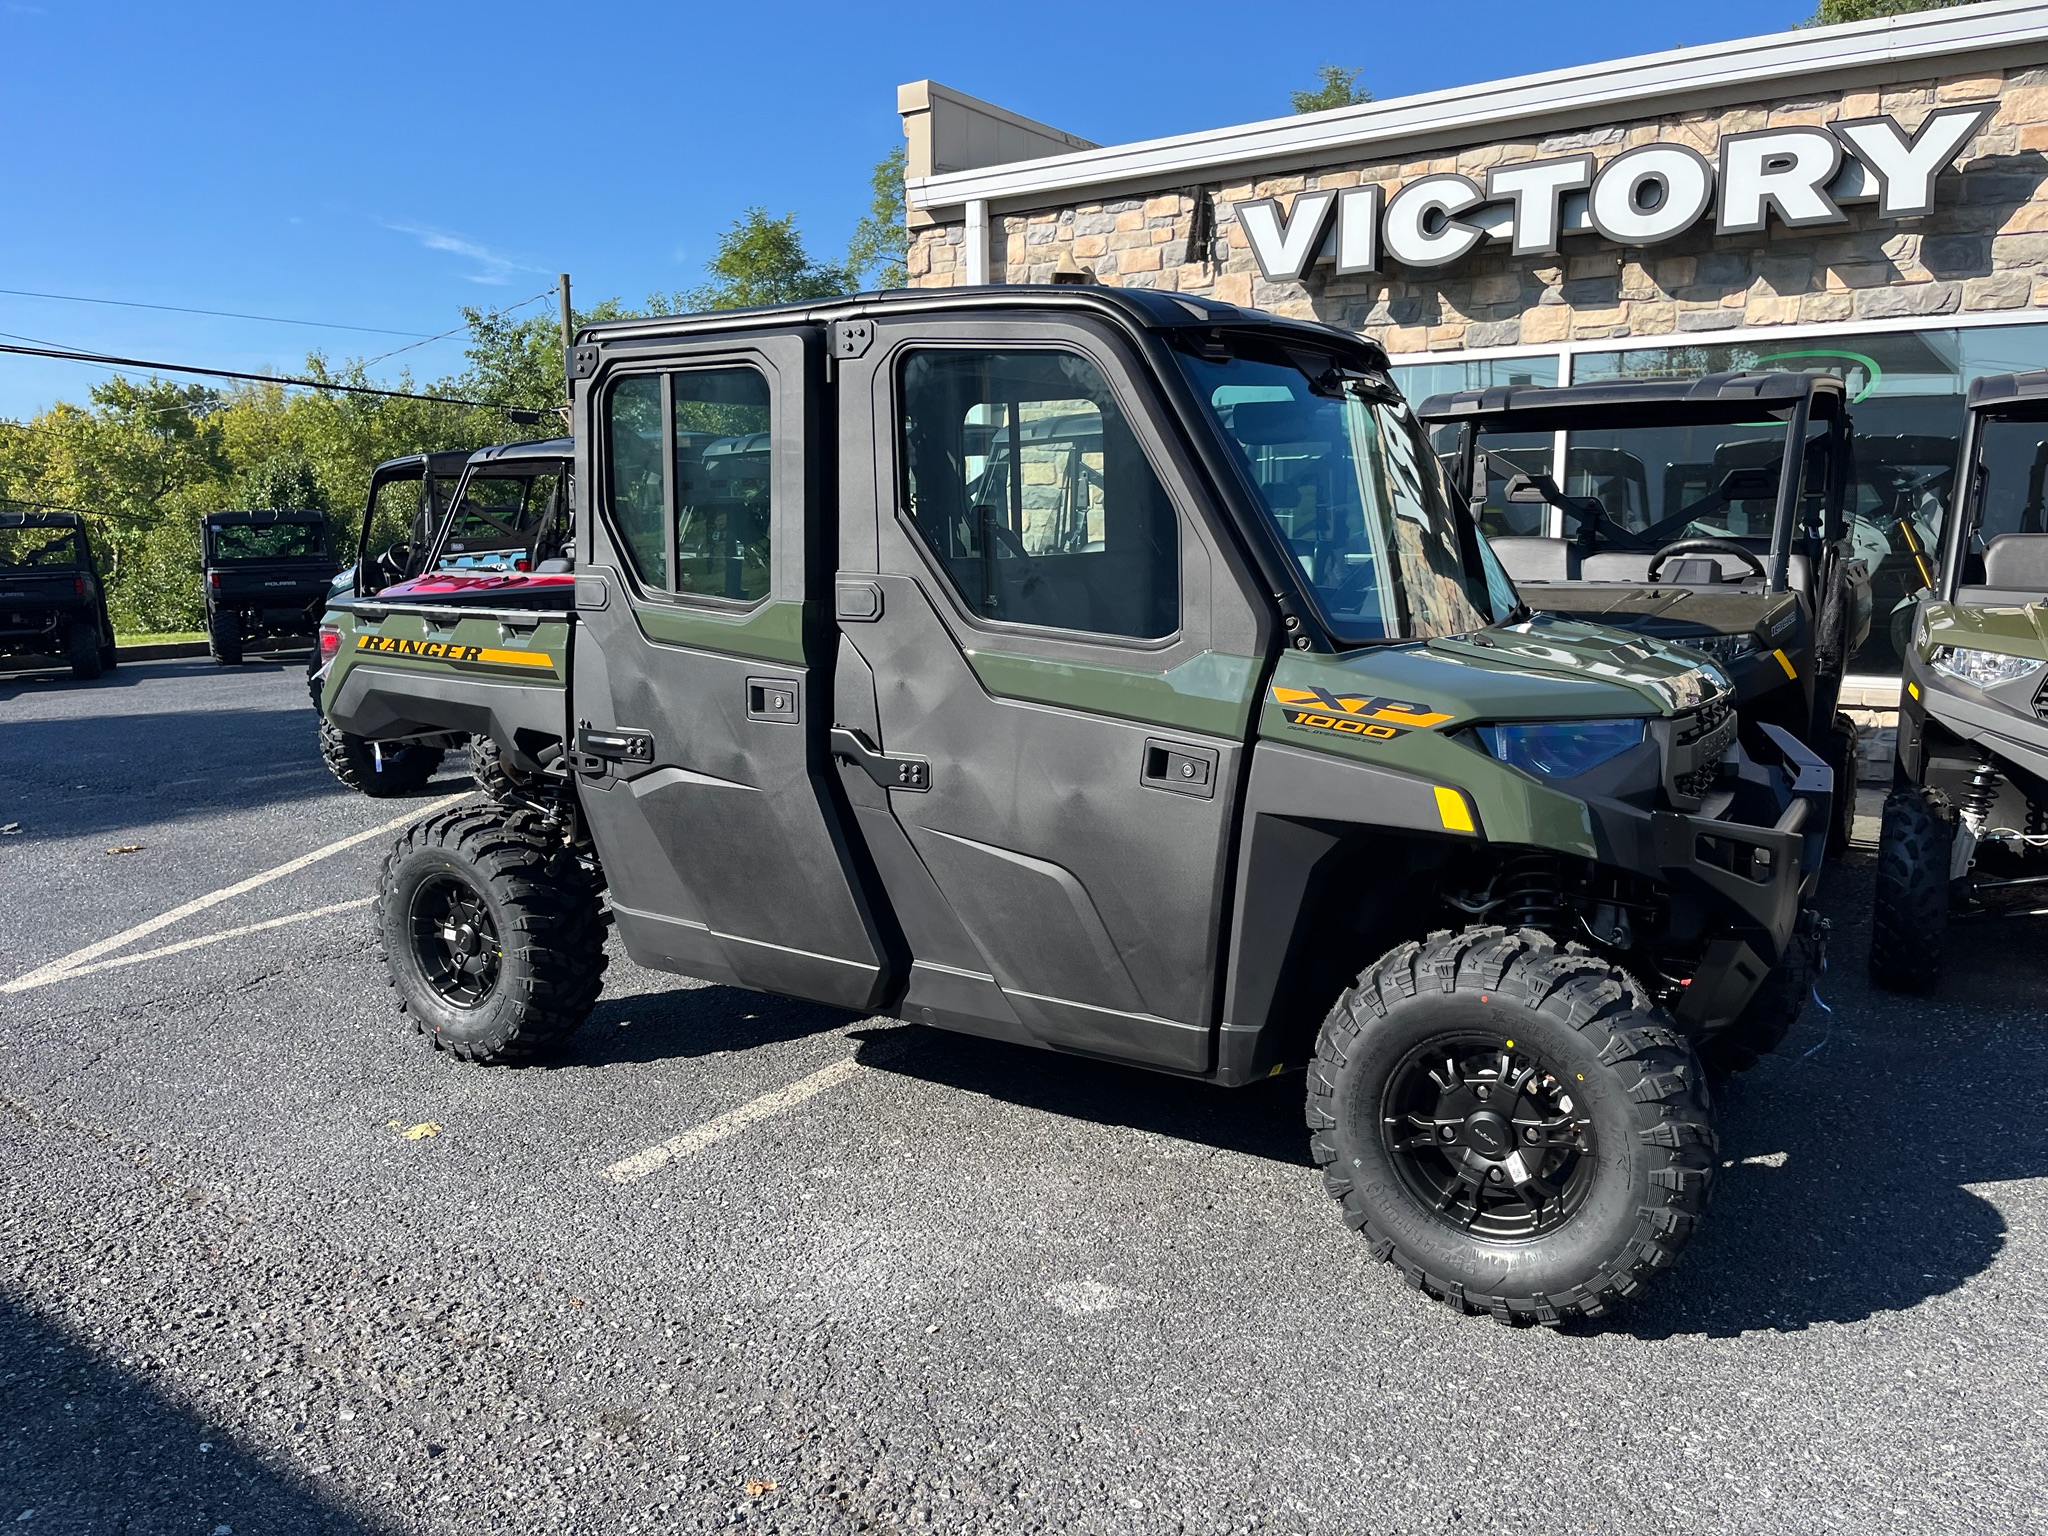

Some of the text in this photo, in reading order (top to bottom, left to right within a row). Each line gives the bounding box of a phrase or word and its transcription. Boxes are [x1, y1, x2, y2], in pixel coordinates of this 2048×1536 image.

[1232, 101, 2001, 283] VICTORY
[363, 635, 483, 662] RANGER
[1285, 685, 1434, 717] XP
[1286, 725, 1383, 746] DUAL OVERHEAD CAM
[1293, 711, 1397, 739] 1000
